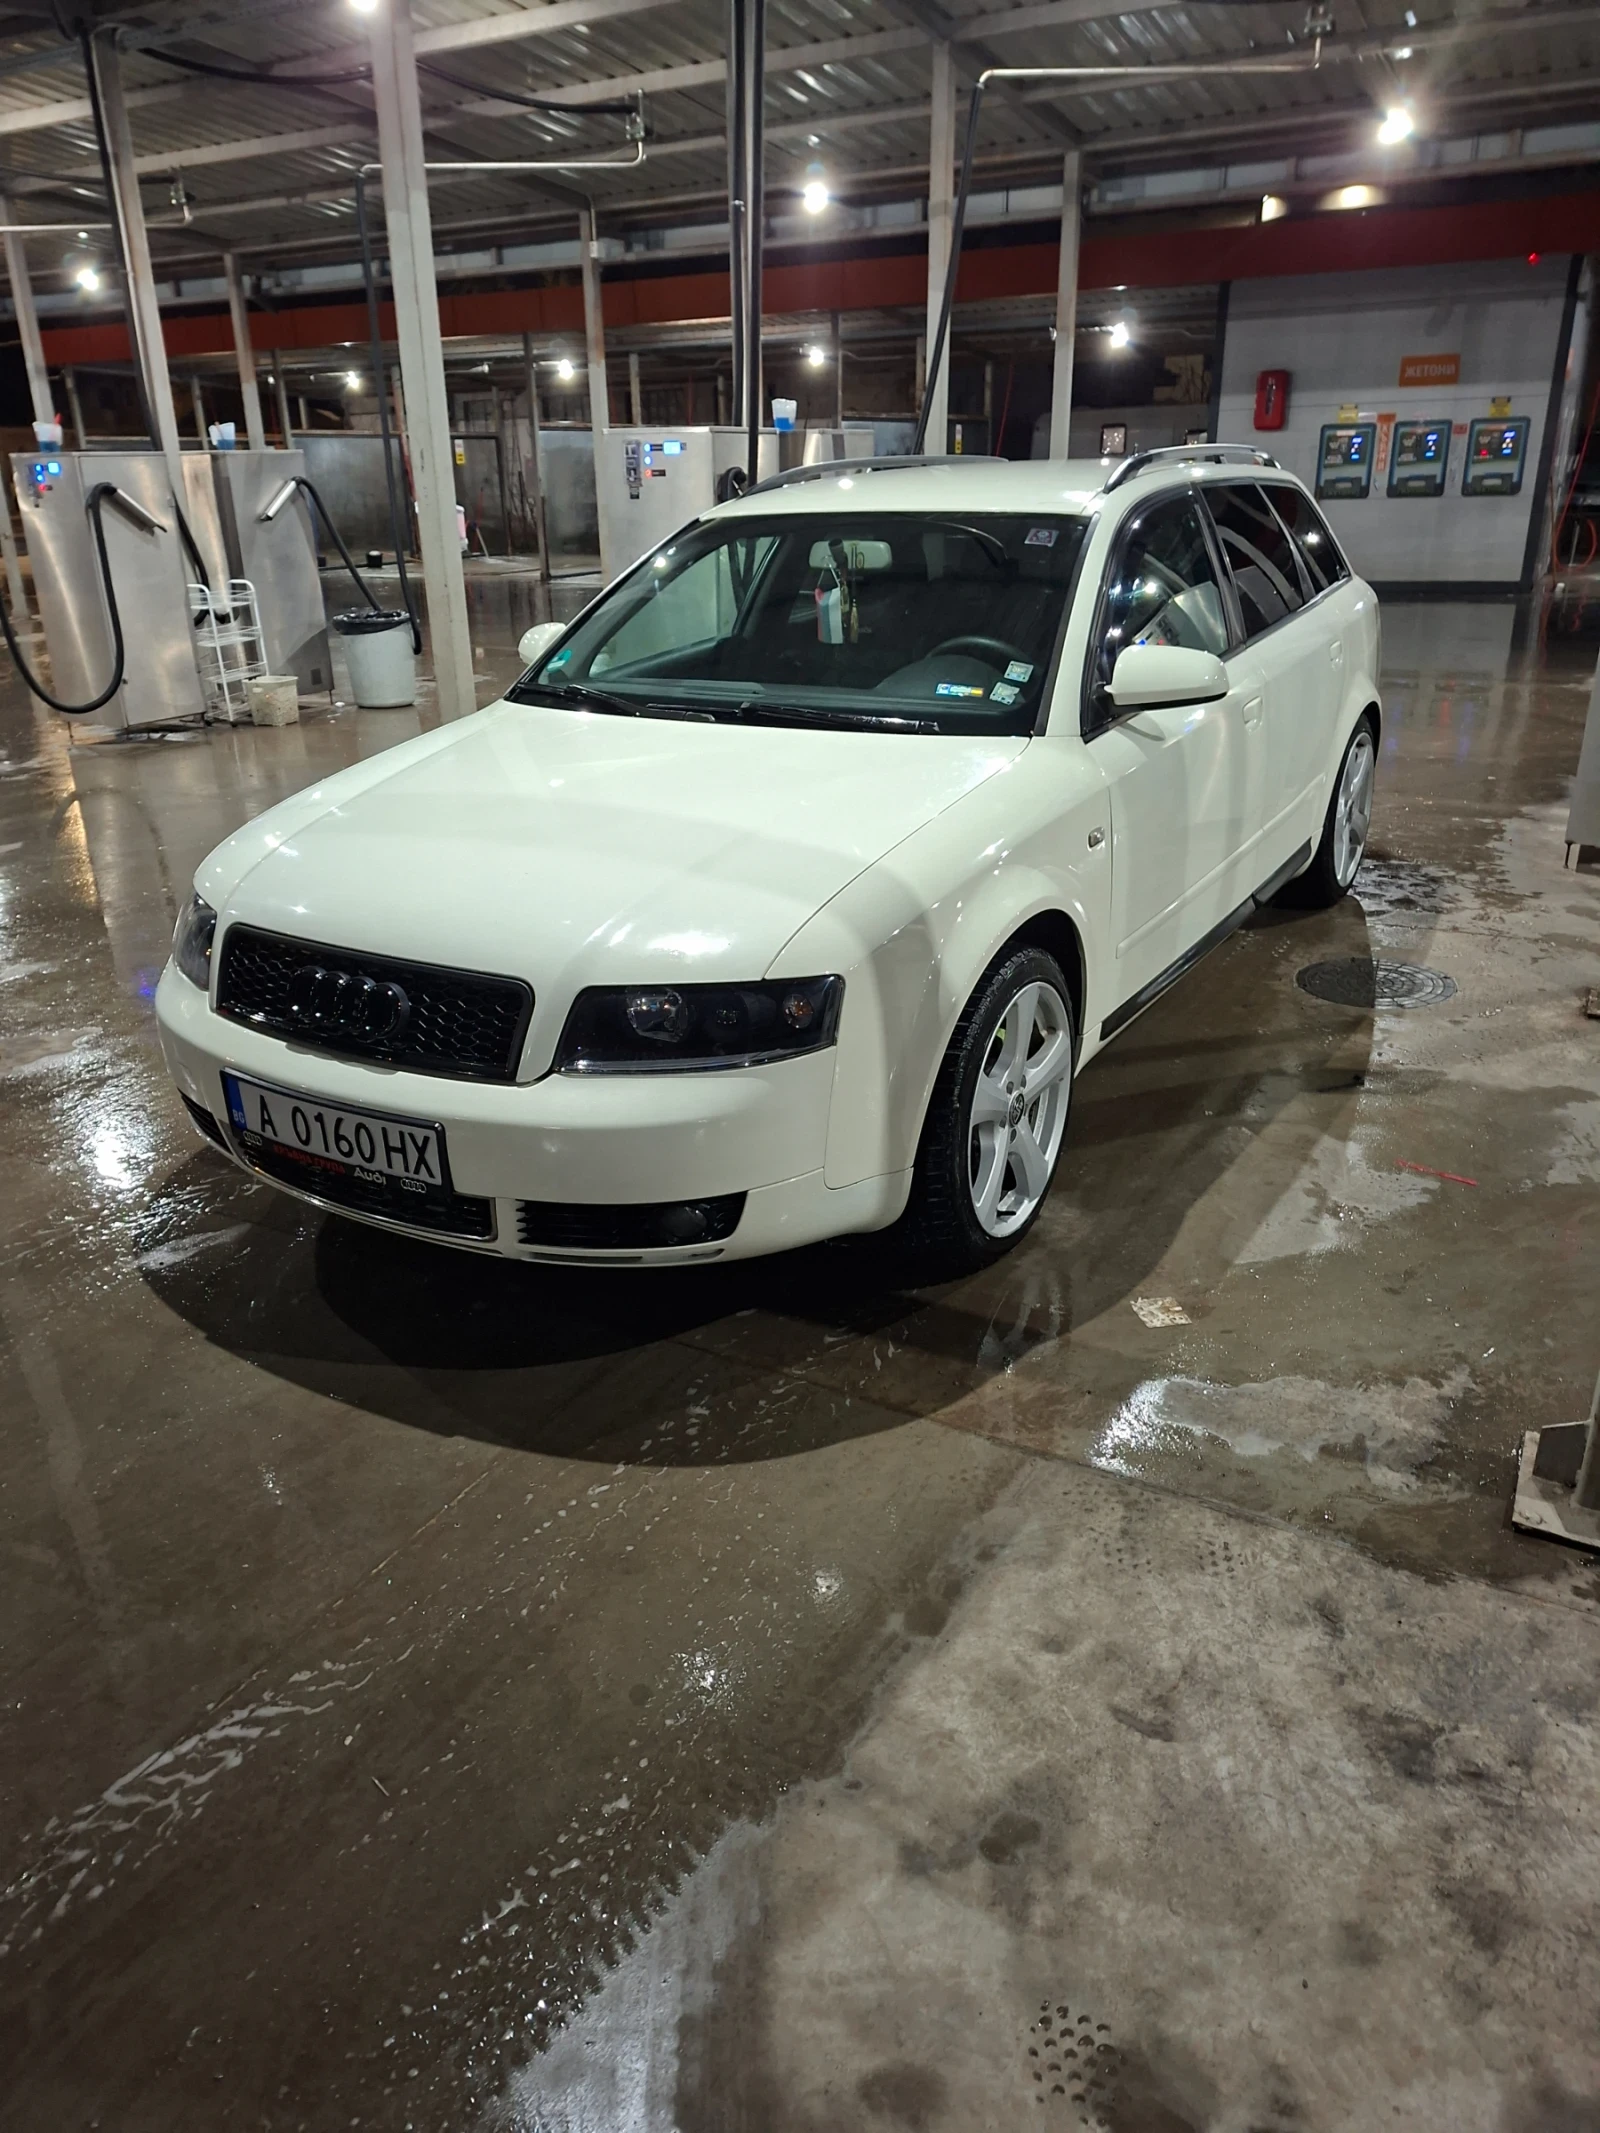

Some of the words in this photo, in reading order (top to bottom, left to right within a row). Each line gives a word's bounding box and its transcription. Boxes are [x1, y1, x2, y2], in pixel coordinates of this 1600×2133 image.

[1404, 364, 1455, 378] ЖЕТОНИ
[232, 1109, 245, 1124] BG
[259, 1094, 278, 1138] A
[353, 1167, 387, 1186] Audi
